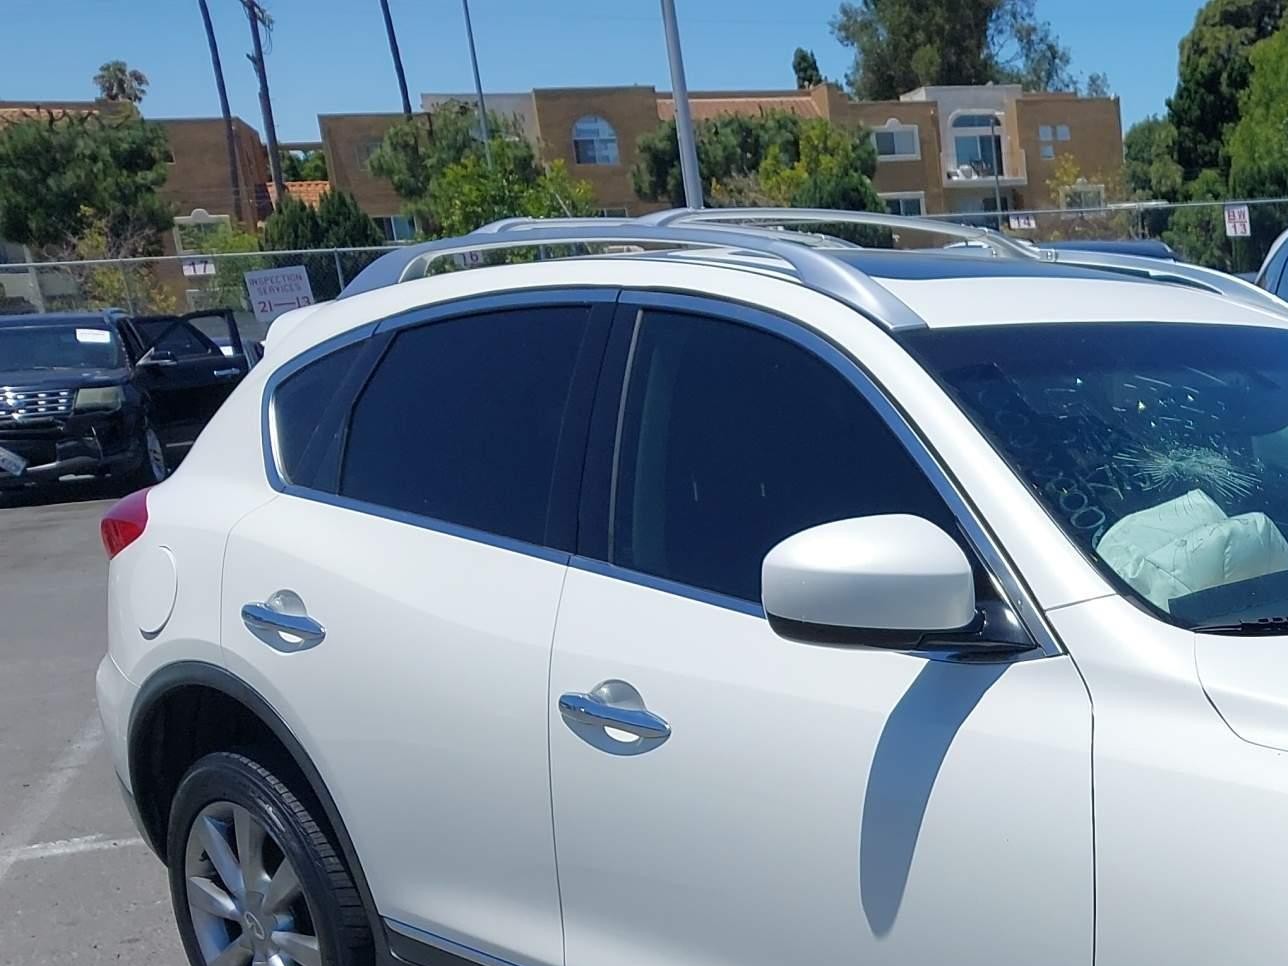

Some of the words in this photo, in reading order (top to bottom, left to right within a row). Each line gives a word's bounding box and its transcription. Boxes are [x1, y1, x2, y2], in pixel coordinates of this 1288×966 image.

[1232, 223, 1248, 235] 13
[188, 260, 208, 274] 17
[249, 274, 303, 287] INSPECTION
